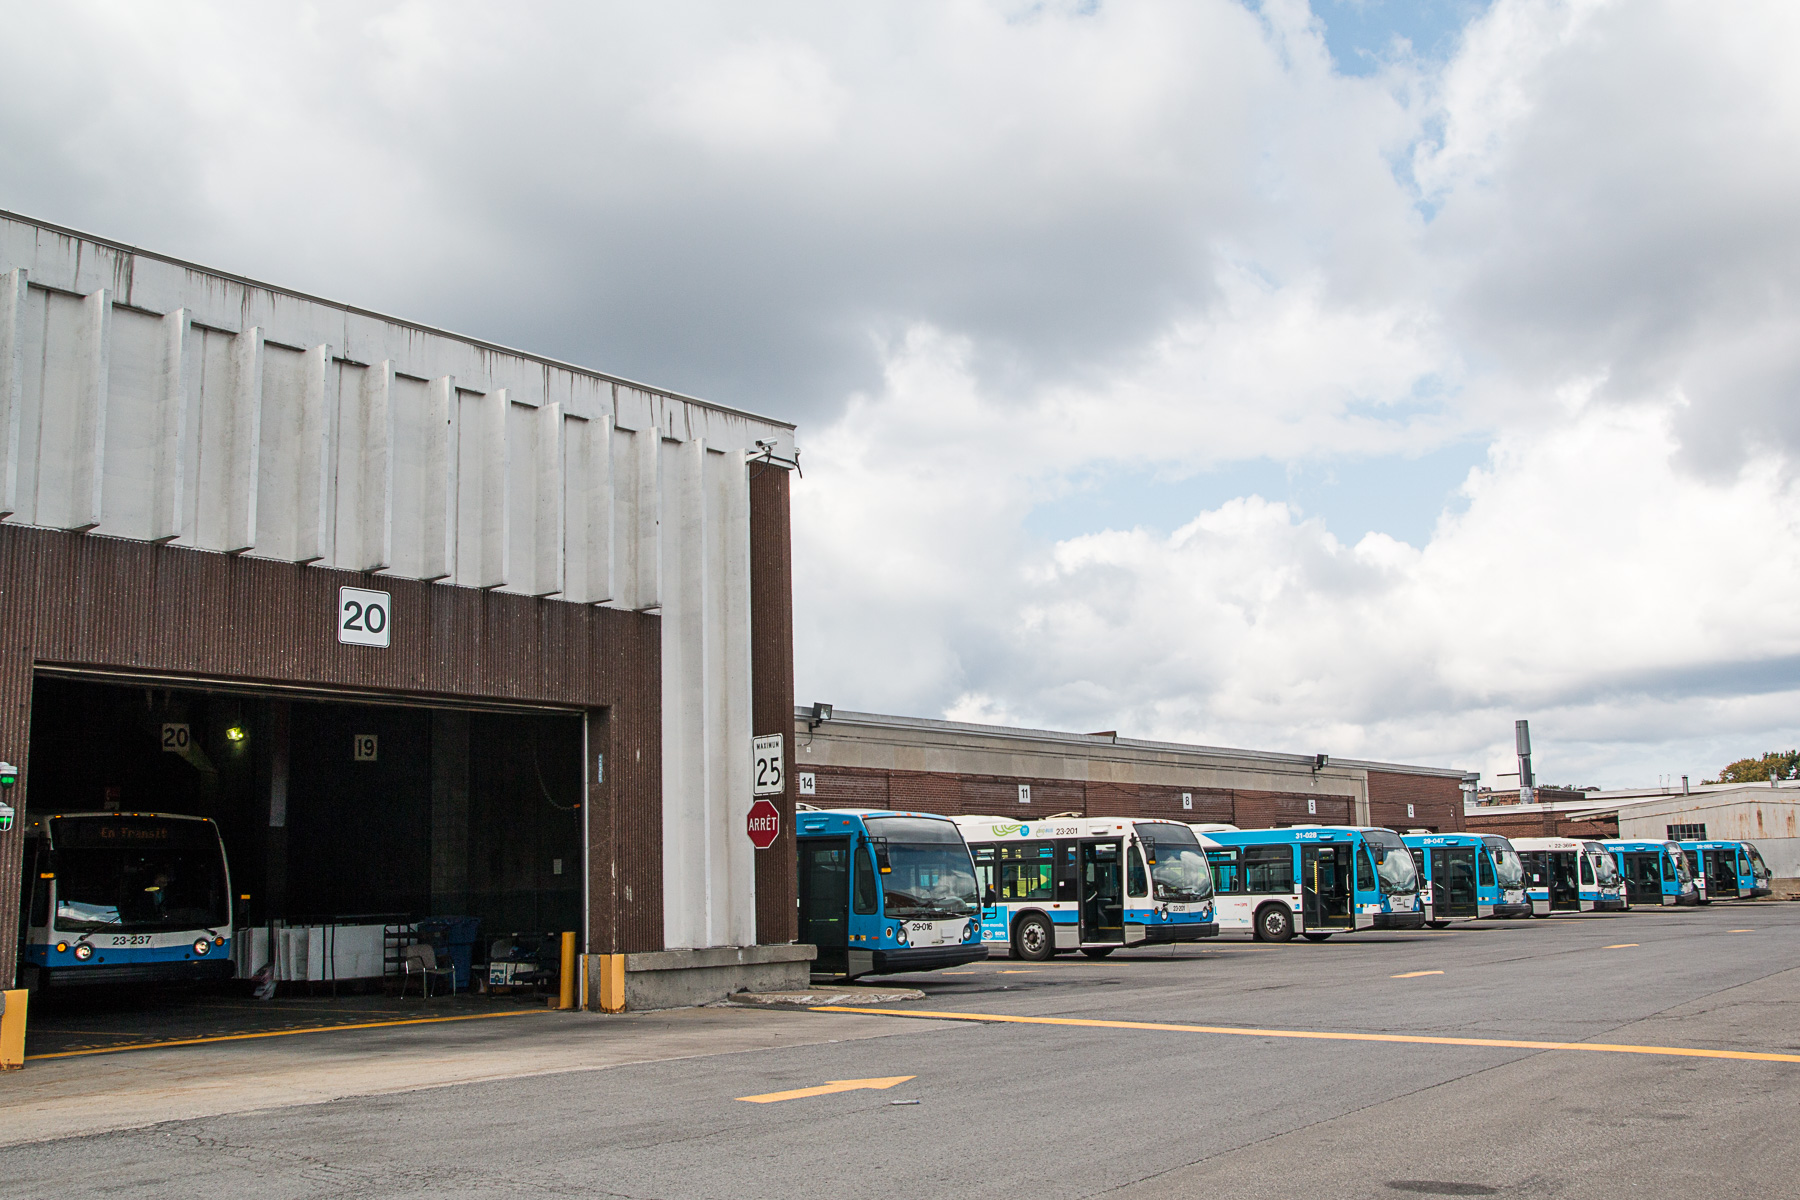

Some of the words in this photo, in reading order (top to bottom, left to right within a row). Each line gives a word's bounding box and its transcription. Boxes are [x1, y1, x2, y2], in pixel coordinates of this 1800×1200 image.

[343, 600, 386, 633] 20
[163, 727, 189, 747] 20
[357, 738, 375, 757] 19
[756, 740, 780, 750] MAXIMUM
[756, 757, 781, 787] 25
[801, 777, 813, 790] 14
[1021, 788, 1028, 799] 11
[1185, 796, 1190, 806] 8
[1310, 802, 1315, 811] 5
[1409, 806, 1413, 815] 2
[748, 814, 777, 832] ARRÊT
[1055, 827, 1078, 836] 23-201
[1423, 837, 1445, 845] 29-047
[912, 922, 933, 932] 29-016
[112, 935, 152, 947] 23-237
